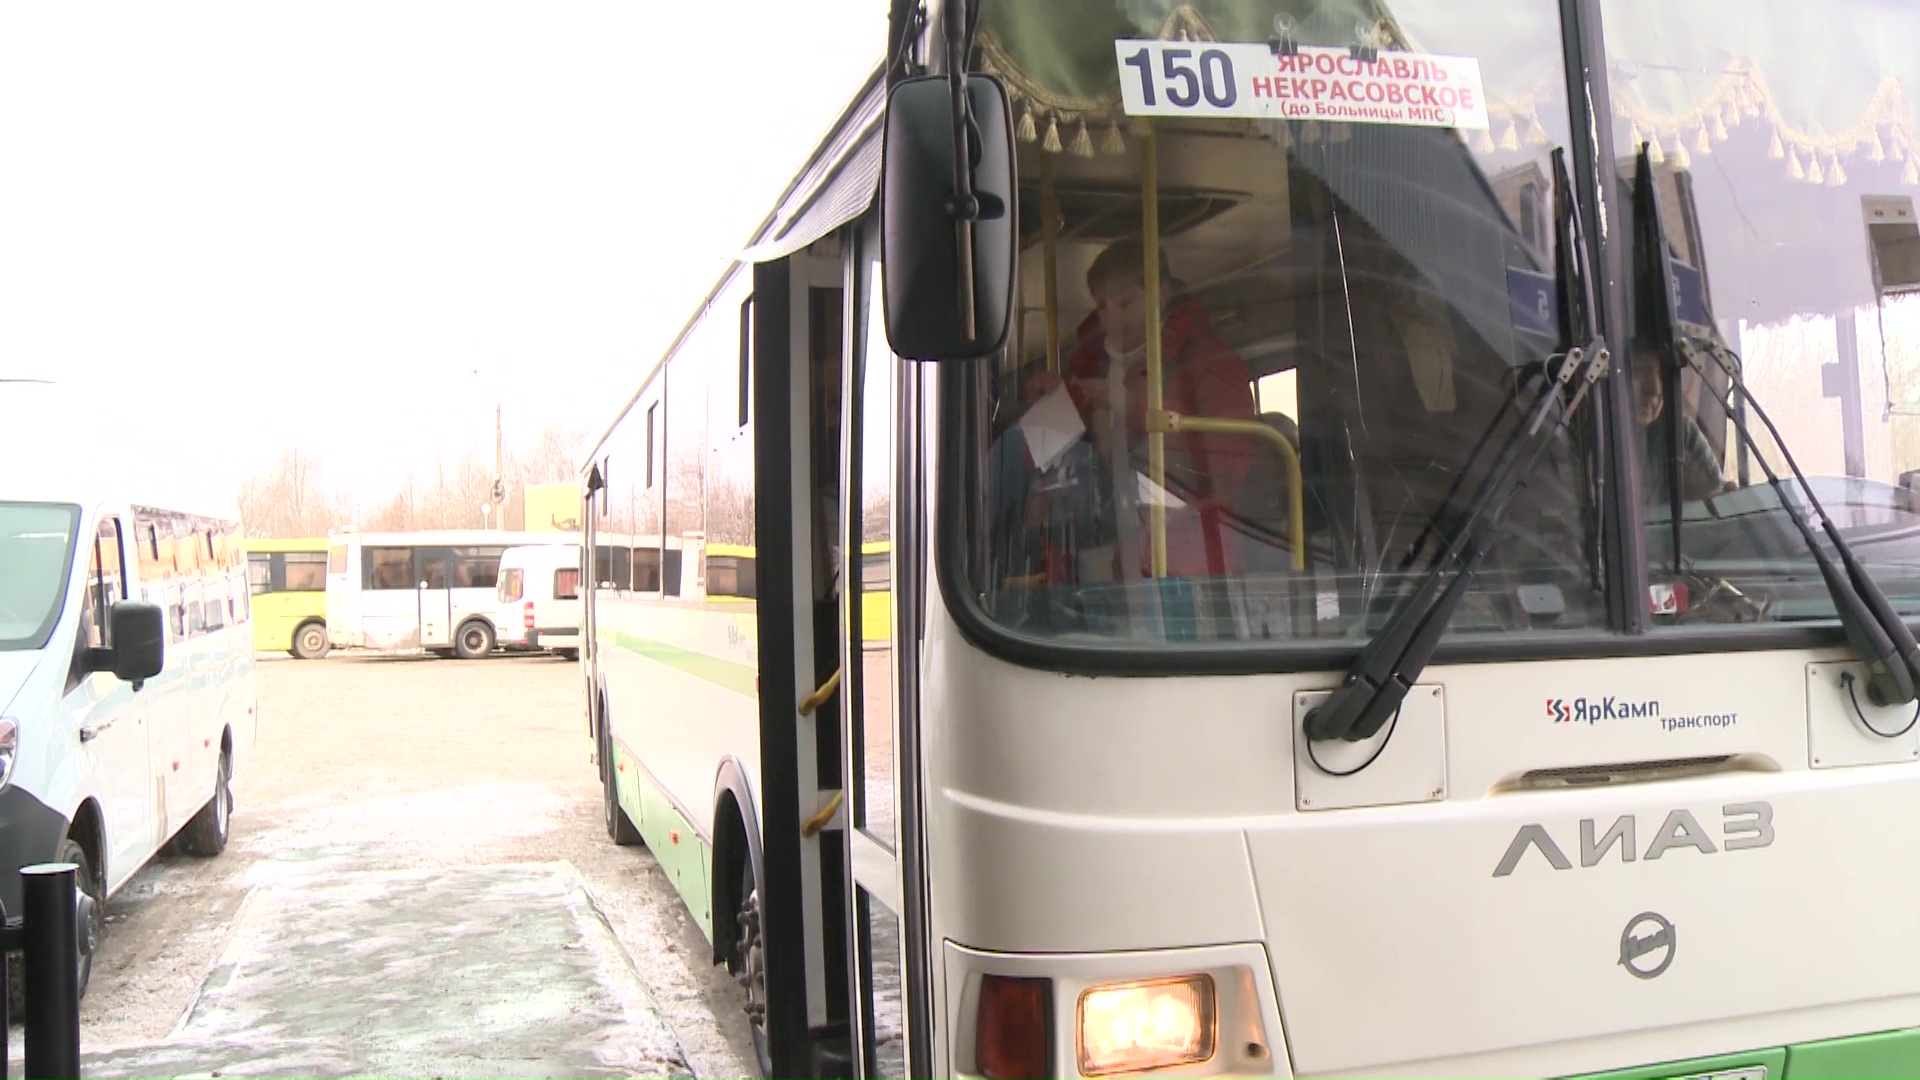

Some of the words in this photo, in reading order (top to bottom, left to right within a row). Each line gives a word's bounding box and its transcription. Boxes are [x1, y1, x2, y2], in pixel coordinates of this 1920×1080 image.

[1125, 47, 1238, 108] 150
[1277, 53, 1448, 82] ЯРОСЛАВЛЬ
[1252, 77, 1475, 110] НЕКРАСОВСКОЕ
[1281, 101, 1310, 117] (до
[1315, 102, 1403, 121] Больницы
[1575, 696, 1660, 725] ЯрКамп
[1660, 713, 1738, 731] транспорт
[1492, 801, 1775, 878] ЛИАЗ
